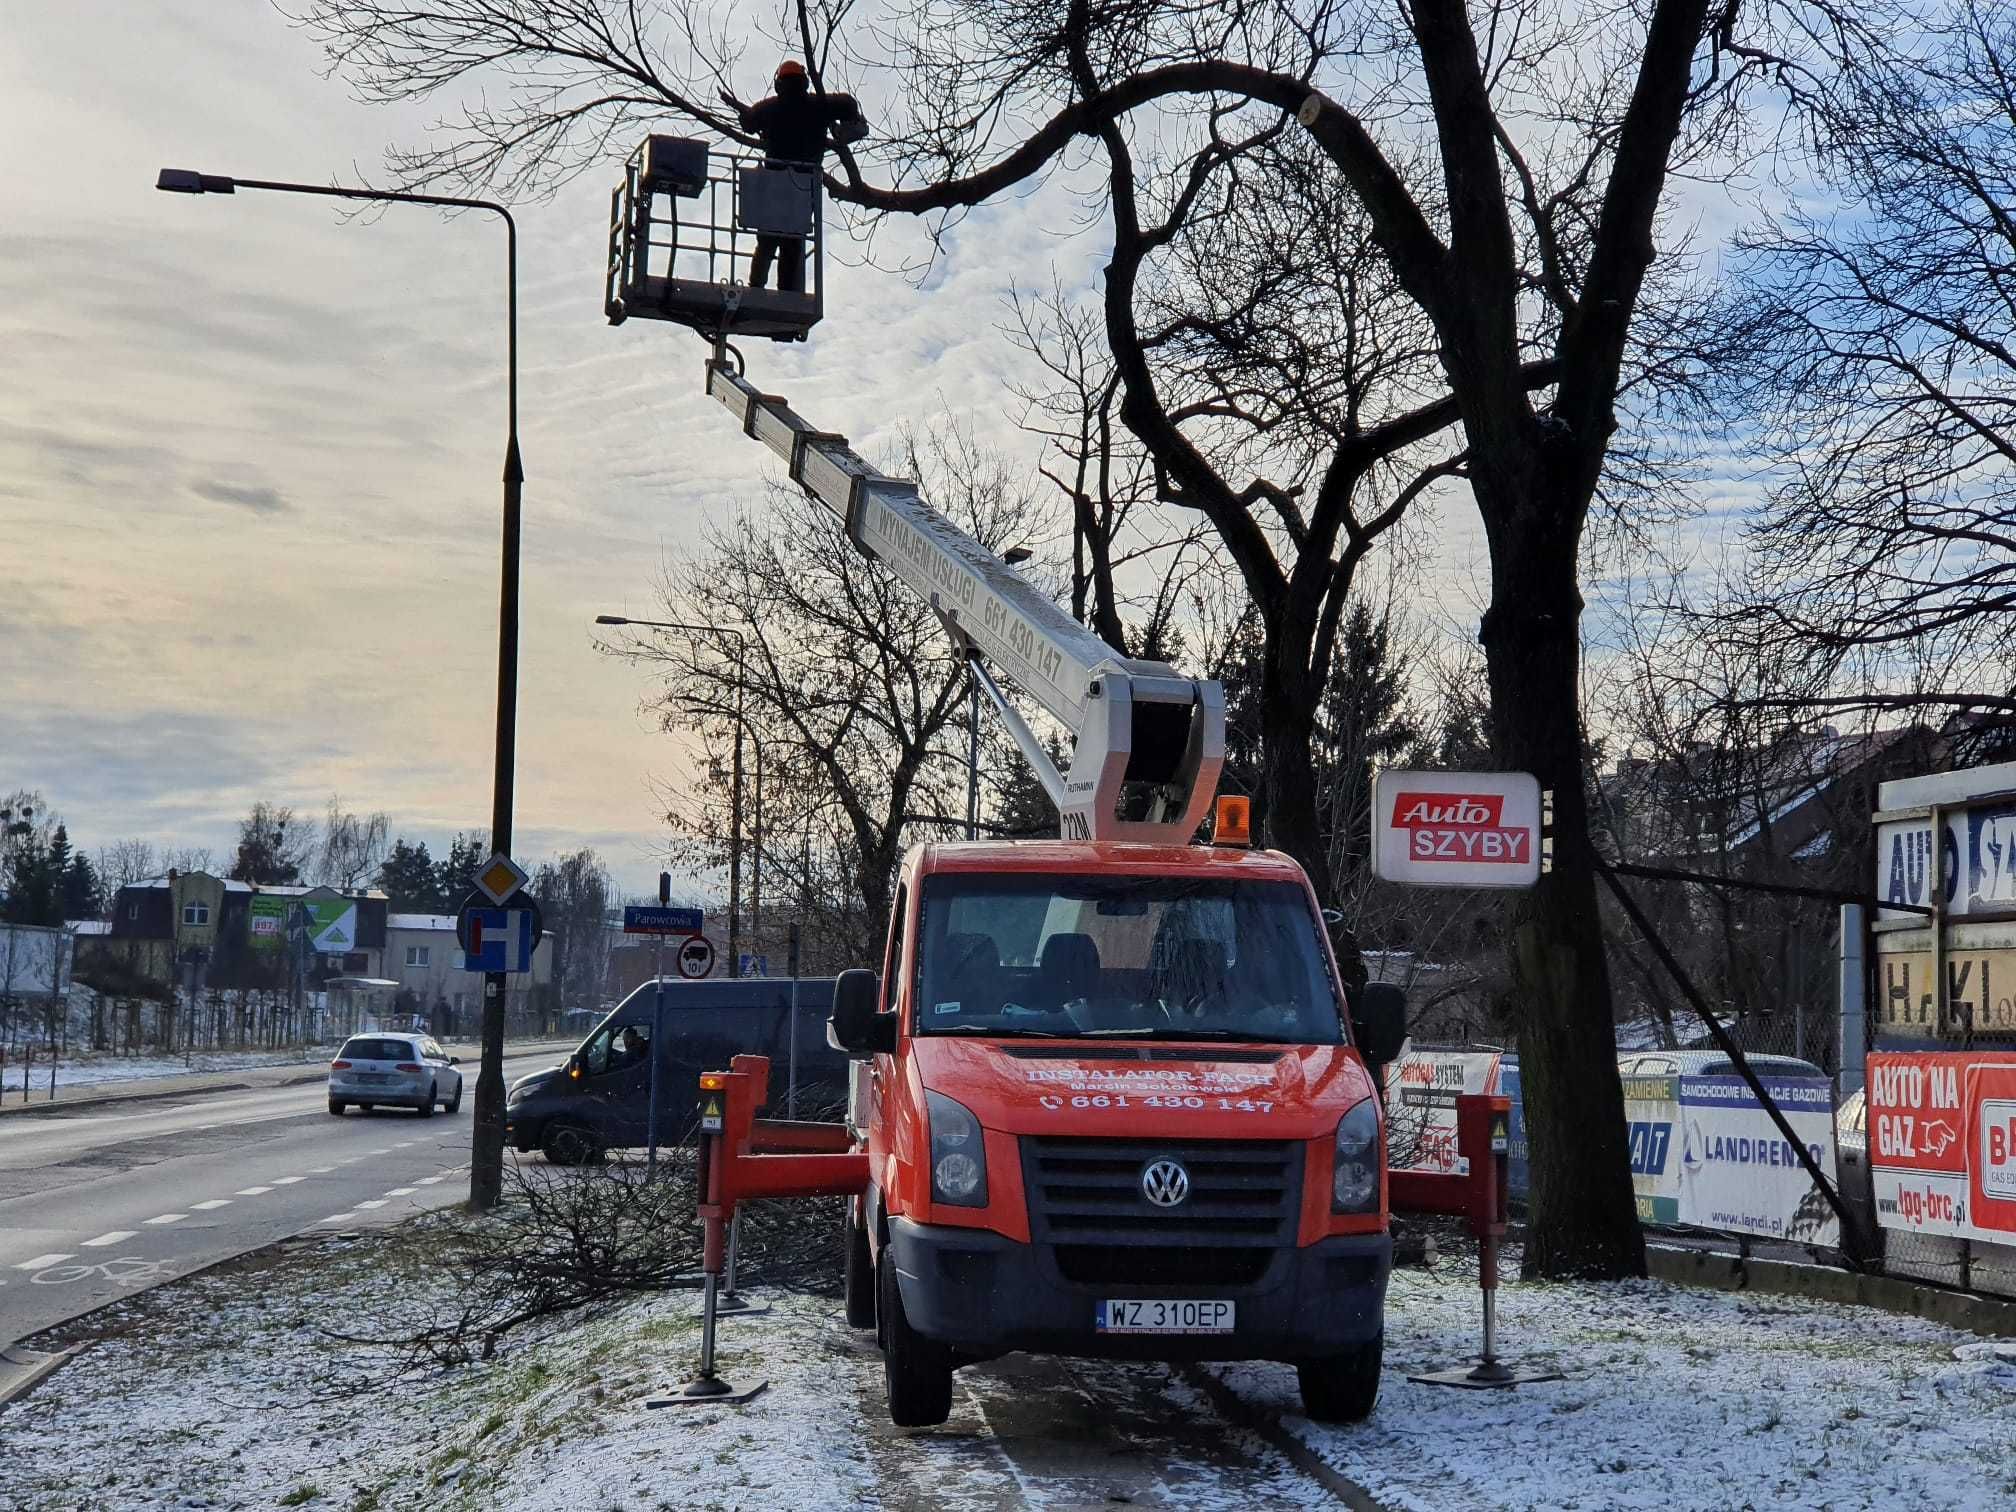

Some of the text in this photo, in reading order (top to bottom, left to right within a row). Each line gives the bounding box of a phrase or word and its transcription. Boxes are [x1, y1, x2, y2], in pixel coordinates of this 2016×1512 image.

[984, 596, 1008, 638] 661
[1009, 618, 1034, 660] 430
[1036, 639, 1062, 681] 147
[1403, 799, 1491, 824] Auto
[1063, 811, 1092, 841] 22M
[1415, 830, 1525, 858] SZYBY
[1027, 1070, 1273, 1086] INSTALATOR-FACH
[1070, 1082, 1131, 1091] Marcin
[1436, 1065, 1464, 1085] SYSTEM
[1872, 1065, 1960, 1109] AUTO NA
[1071, 1095, 1274, 1113] 661 430 147
[1681, 1083, 1831, 1103] SAMOCHODOWE INSACJE GAZOWE
[1878, 1114, 1916, 1158] GAZ
[1705, 1135, 1822, 1169] LANDIRENO
[1879, 1181, 1966, 1227] www.lpg-brc.pl
[1712, 1210, 1783, 1232] www.landi.pl
[1112, 1302, 1143, 1326] WZ
[1153, 1302, 1228, 1326] 310EP
